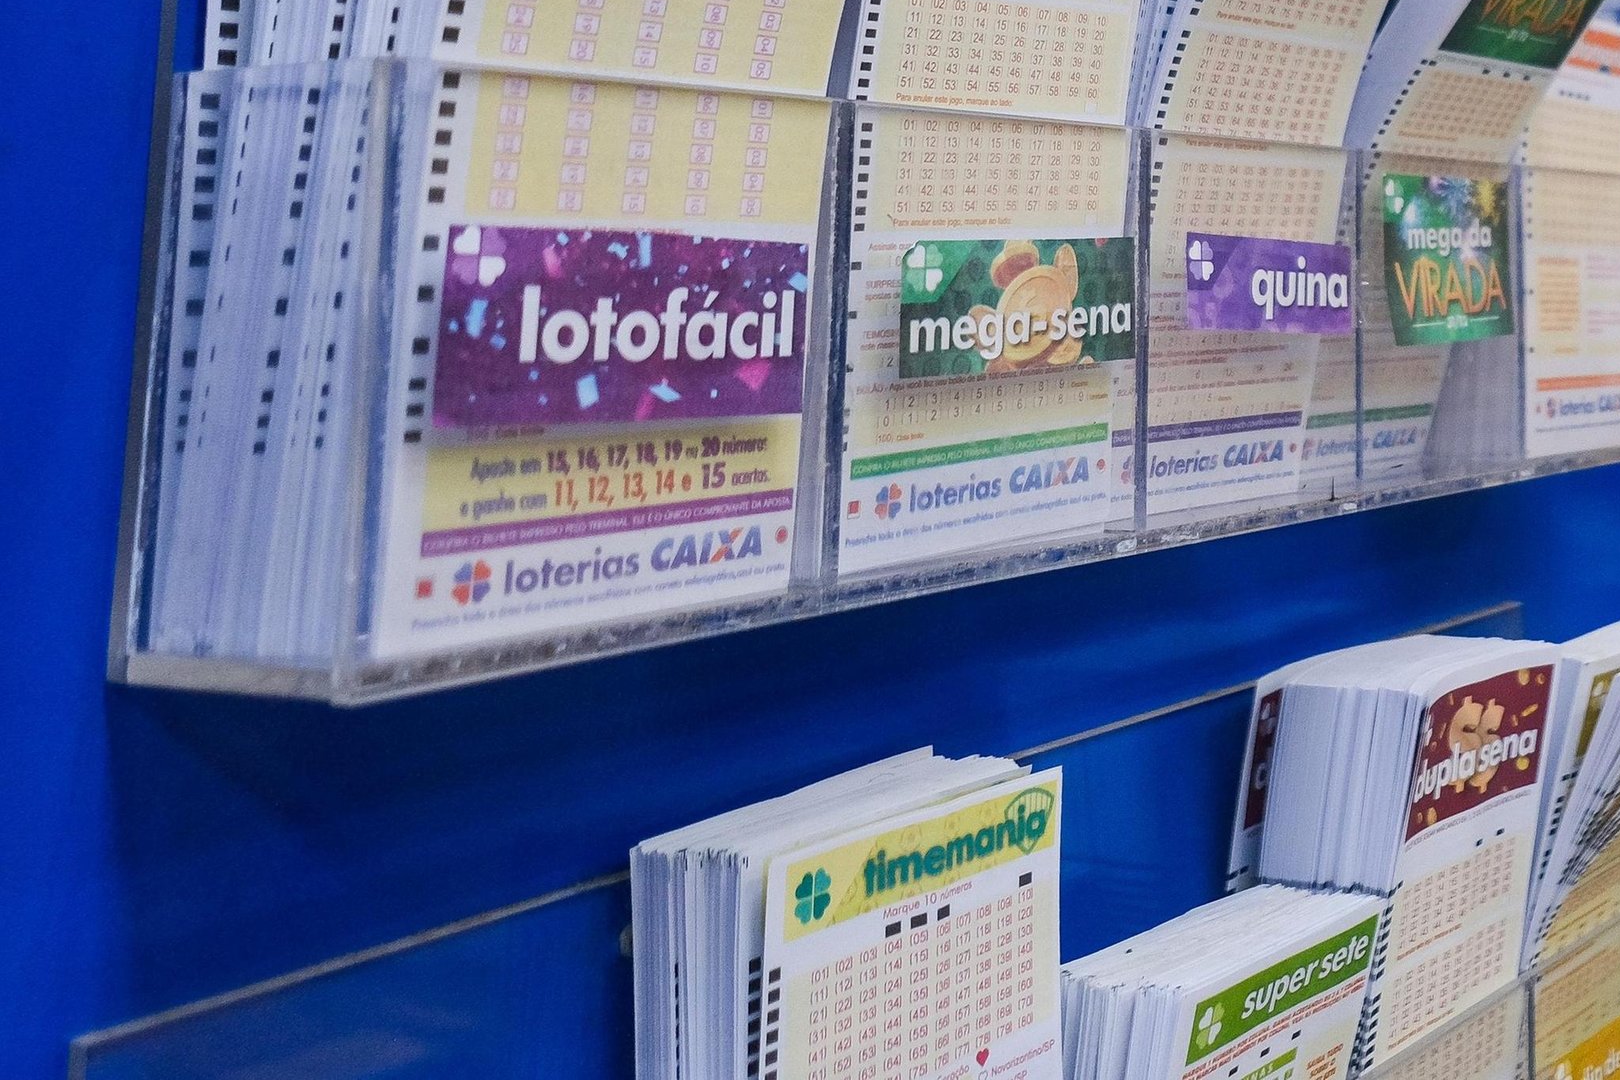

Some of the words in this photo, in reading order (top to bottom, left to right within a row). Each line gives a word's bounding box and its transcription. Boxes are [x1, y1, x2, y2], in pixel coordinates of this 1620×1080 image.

[1408, 226, 1462, 256] mega
[1469, 218, 1492, 248] da
[1251, 255, 1349, 320] quina
[1394, 256, 1508, 319] VIRADA
[519, 284, 795, 364] lotofácil
[909, 302, 1132, 360] mega-sena
[555, 478, 578, 511] 11,
[588, 475, 615, 506] 12,
[623, 471, 647, 502] 13,
[656, 469, 675, 495] 14
[701, 461, 726, 489] 15
[910, 473, 1002, 513] loterias
[1008, 456, 1089, 494] CAIXA
[1150, 450, 1218, 479] loterias
[1223, 439, 1284, 468] CAIXA
[504, 547, 640, 596] loterias
[651, 525, 763, 571] CAIXA
[1413, 742, 1477, 803] dupla
[1477, 728, 1539, 772] sena
[863, 804, 1047, 898] timemania
[882, 900, 920, 919] Marque
[925, 892, 937, 906] 10
[940, 881, 972, 901] números
[1241, 959, 1319, 1019] super
[1318, 934, 1369, 979] sete
